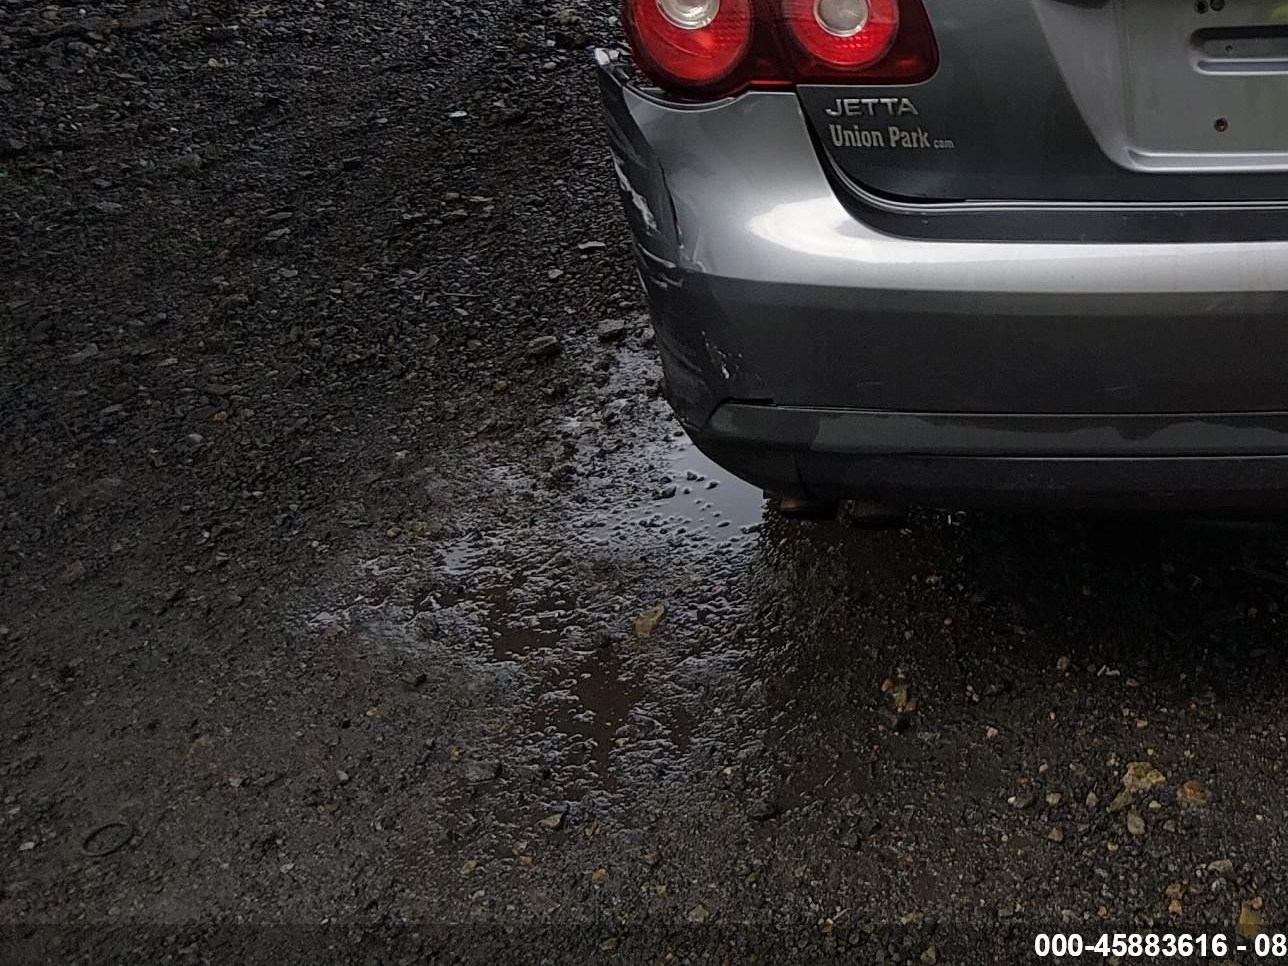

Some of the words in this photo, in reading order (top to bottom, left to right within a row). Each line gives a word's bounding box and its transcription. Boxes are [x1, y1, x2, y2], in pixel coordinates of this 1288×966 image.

[825, 98, 919, 116] JETTA
[829, 124, 884, 147] Union
[887, 126, 931, 148] Park
